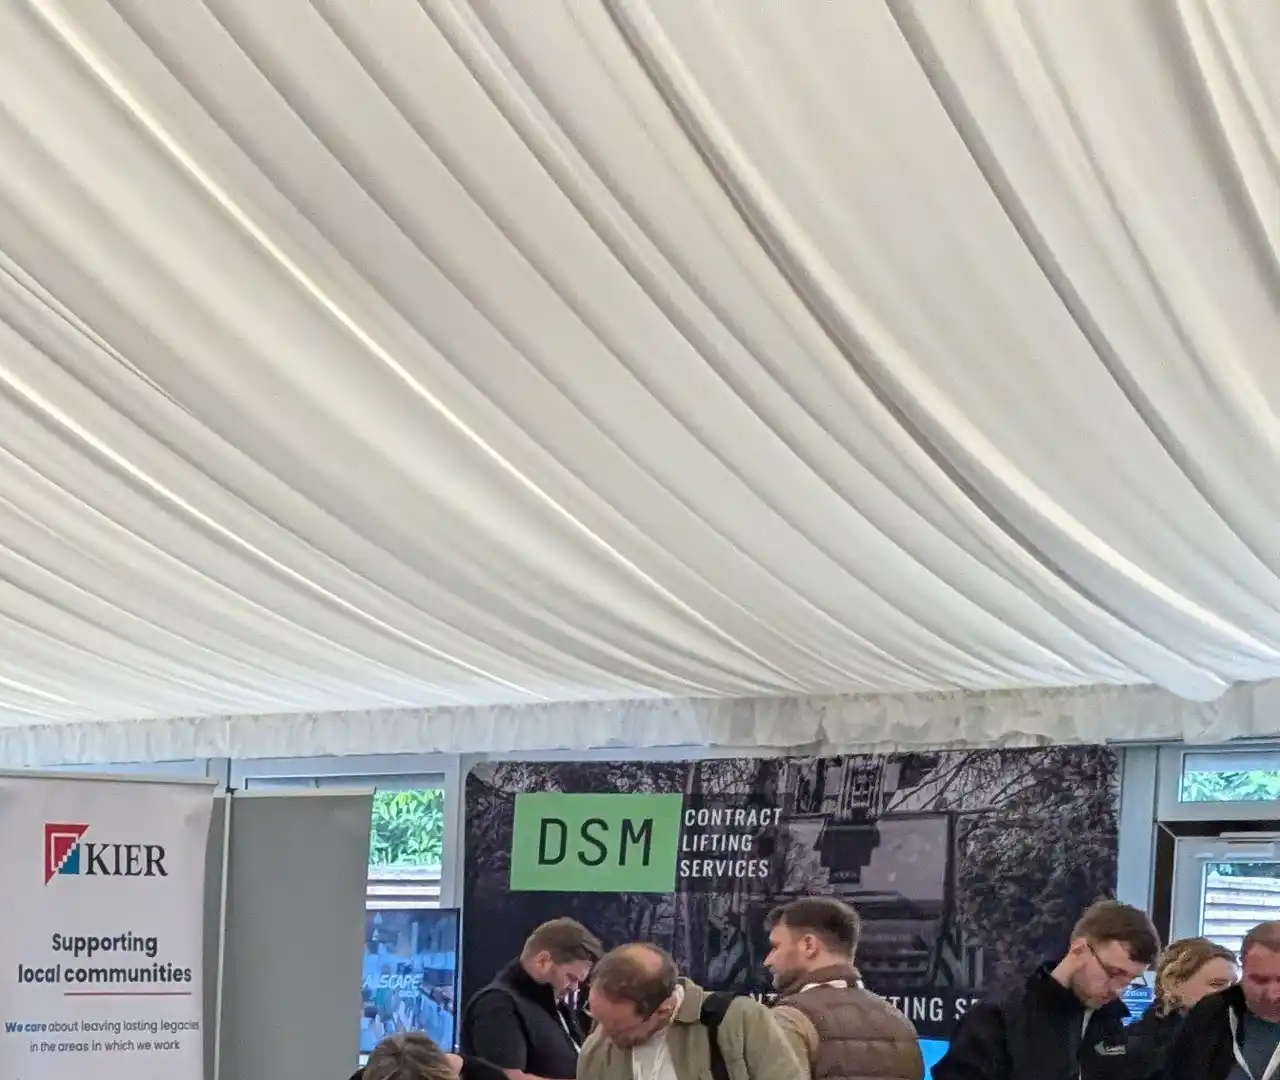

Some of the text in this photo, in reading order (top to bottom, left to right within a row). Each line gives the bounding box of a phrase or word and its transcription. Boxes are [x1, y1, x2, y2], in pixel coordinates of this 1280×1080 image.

[684, 808, 783, 827] CONTRACT
[538, 818, 654, 867] DSM
[681, 834, 753, 852] LIFTING
[85, 843, 168, 877] KIER
[679, 860, 769, 878] SERVICES
[52, 931, 158, 958] Supporting
[18, 962, 192, 983] local communities
[881, 996, 944, 1021] TING
[5, 1021, 23, 1033] We
[25, 1023, 47, 1032] care
[48, 1021, 78, 1032] about
[81, 1020, 121, 1034] leaving
[123, 1019, 158, 1034] lasting
[40, 1041, 56, 1052] the
[58, 1042, 89, 1052] areas
[91, 1040, 102, 1052] in
[104, 1040, 134, 1052] which
[137, 1041, 152, 1051] we
[154, 1039, 180, 1050] work
